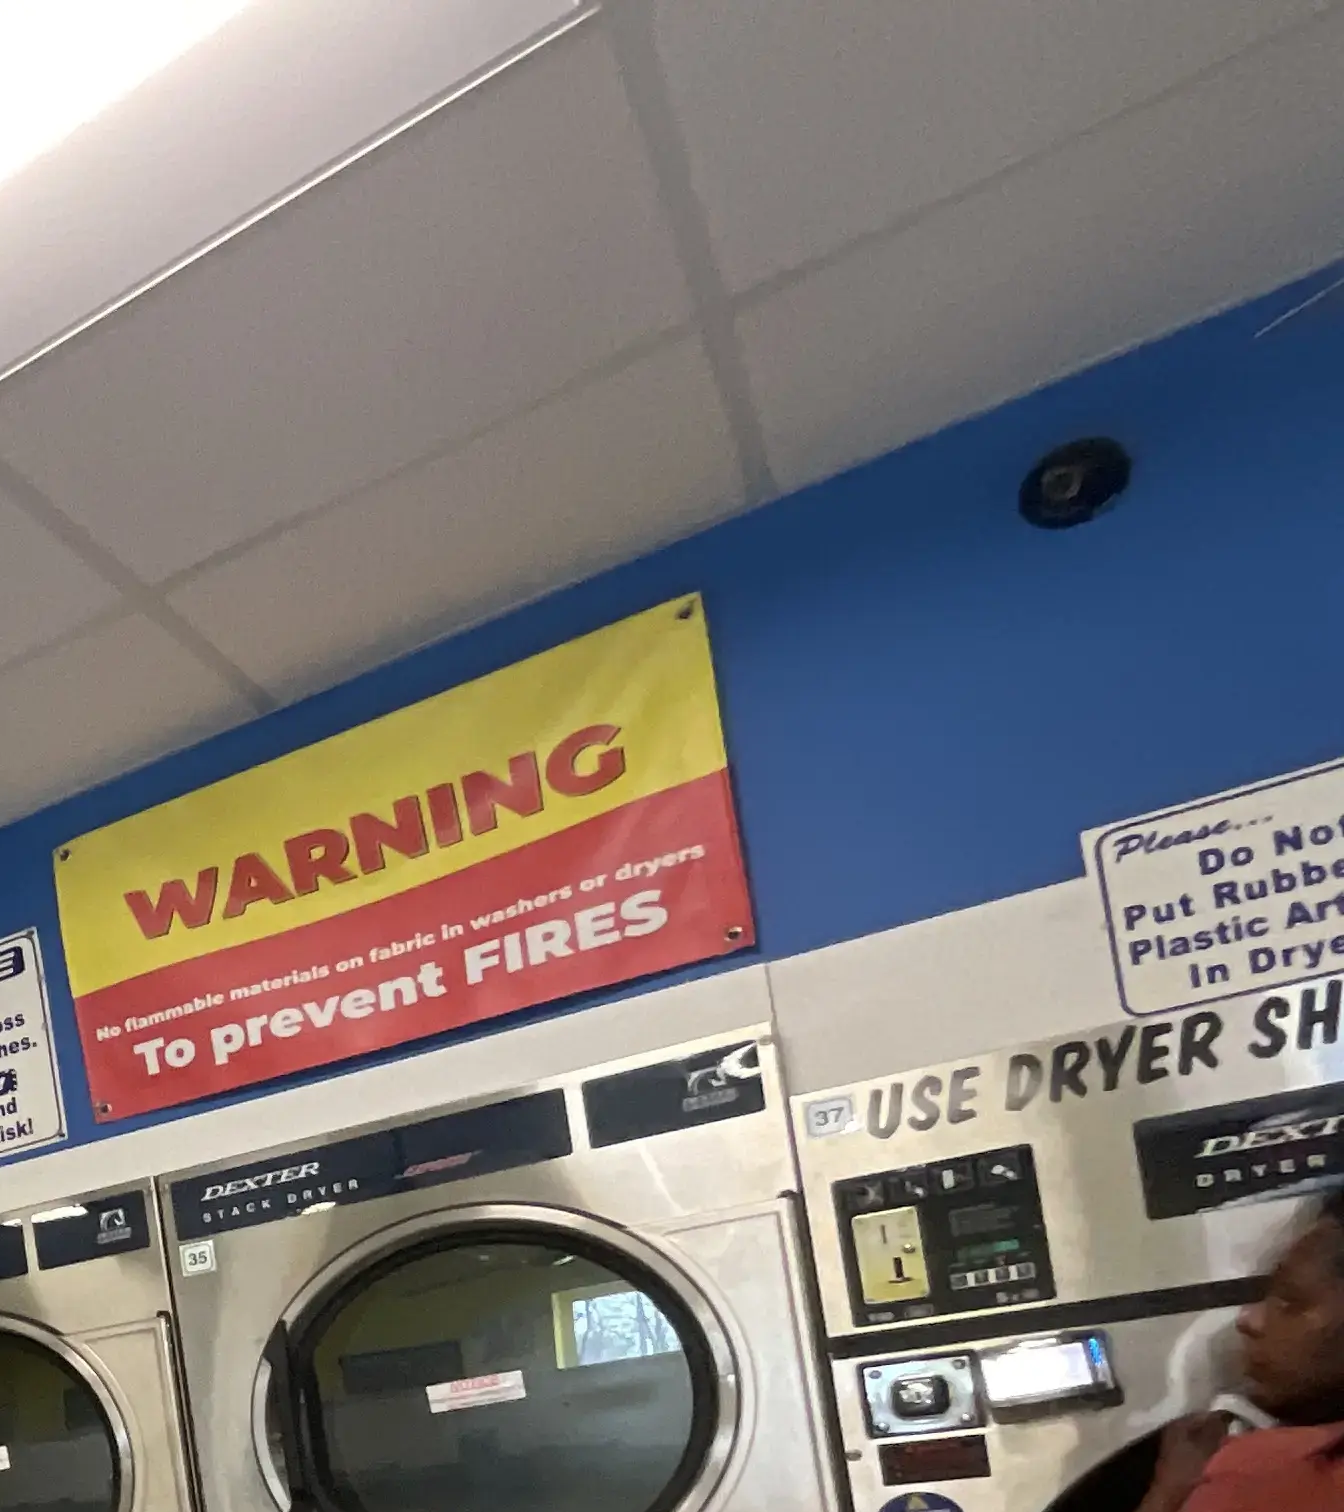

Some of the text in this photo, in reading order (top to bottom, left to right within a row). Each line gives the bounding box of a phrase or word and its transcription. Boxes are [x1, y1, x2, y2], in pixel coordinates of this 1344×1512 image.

[123, 724, 627, 940] WARNING
[1198, 846, 1254, 876] Do
[1123, 893, 1196, 931] Put
[96, 842, 707, 1043] No flammable materials on fabric in washers or dryers
[1129, 915, 1269, 966] Plastic
[133, 889, 669, 1076] To prevent FIRES
[1189, 963, 1230, 988] In
[866, 1066, 981, 1140] USE
[1005, 1011, 1224, 1112] DRYER
[815, 1106, 844, 1128] 37
[201, 1161, 320, 1202] DEXTER
[202, 1178, 360, 1224] STACK DRYER
[187, 1250, 208, 1267] 35
